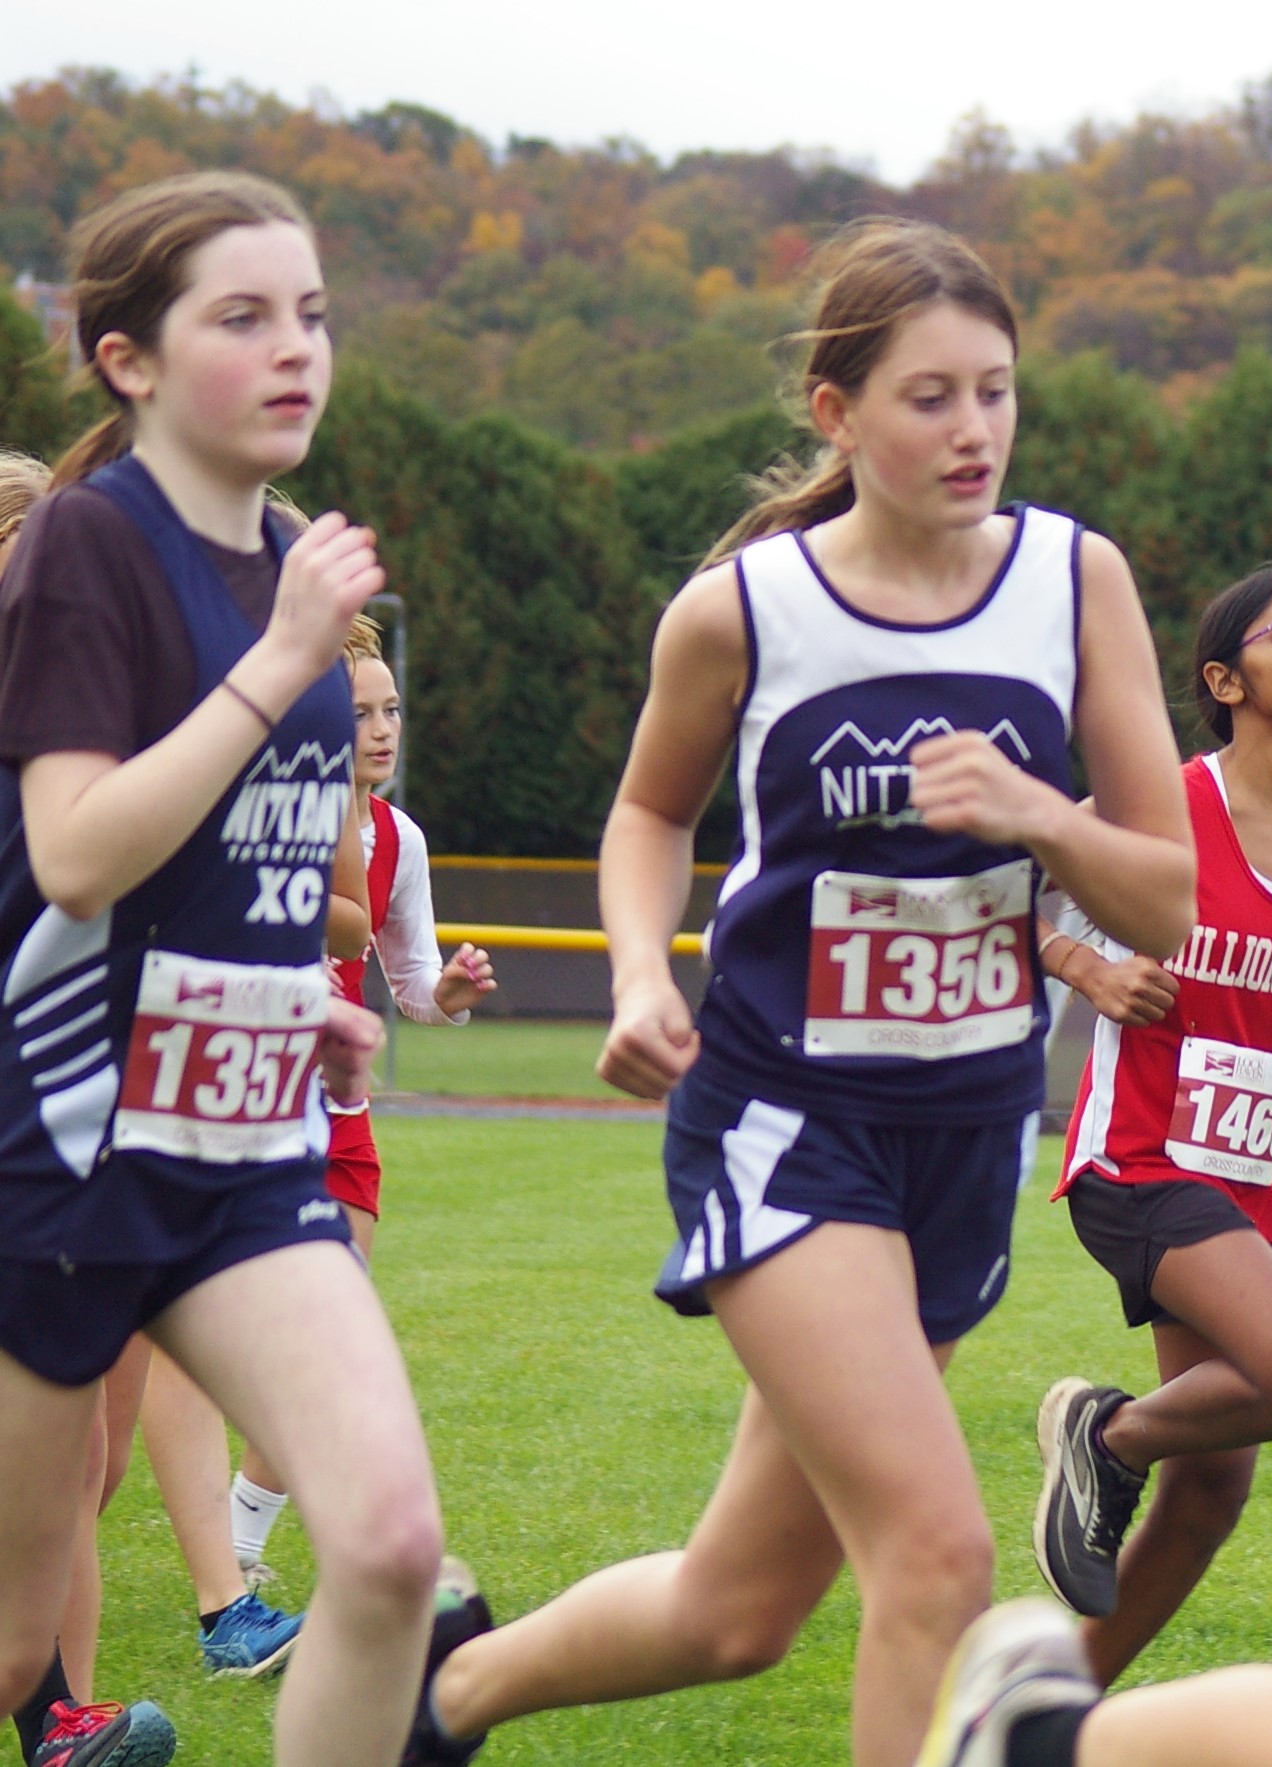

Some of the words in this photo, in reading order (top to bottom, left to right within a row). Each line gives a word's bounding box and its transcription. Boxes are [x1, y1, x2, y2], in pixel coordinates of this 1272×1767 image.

[244, 866, 325, 927] XC
[829, 923, 1020, 1018] 1356
[148, 1021, 319, 1120] 1357
